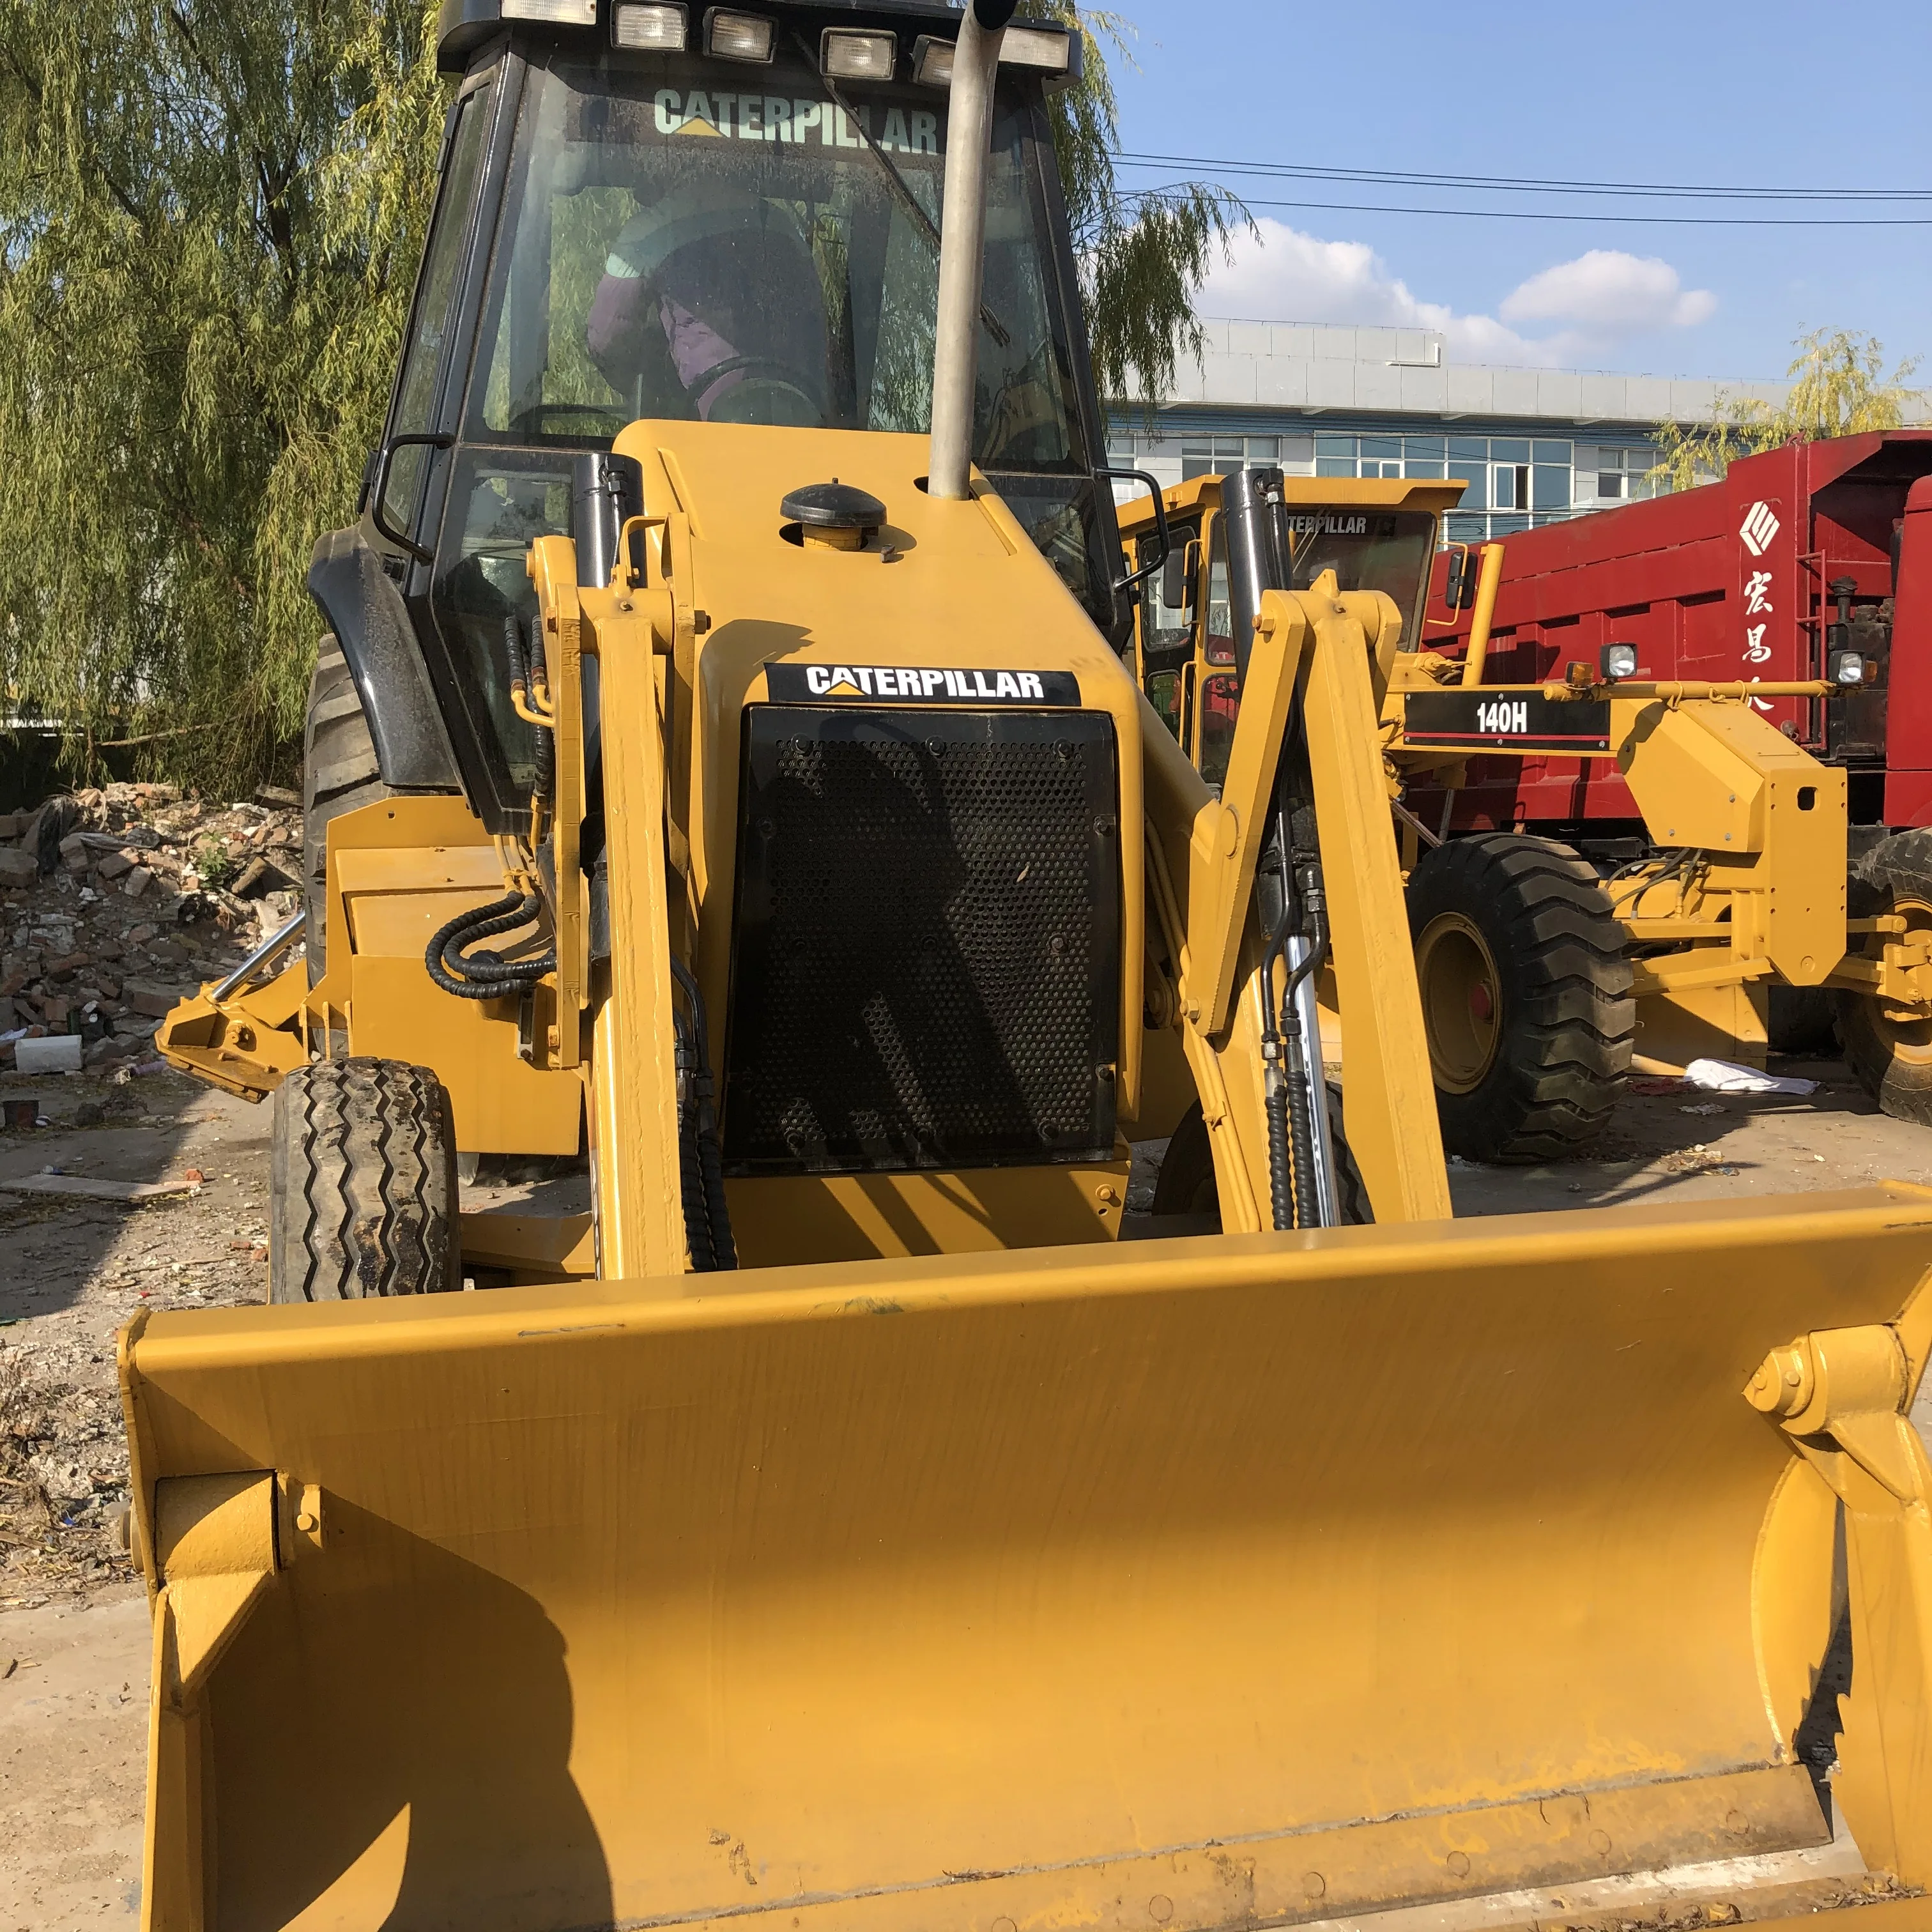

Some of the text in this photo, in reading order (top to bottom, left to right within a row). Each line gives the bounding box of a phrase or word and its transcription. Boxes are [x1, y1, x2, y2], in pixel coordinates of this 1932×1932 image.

[654, 89, 937, 155] CATERPILLAR
[806, 666, 1044, 698] CATERPILLAR
[1476, 702, 1528, 733] 140H
